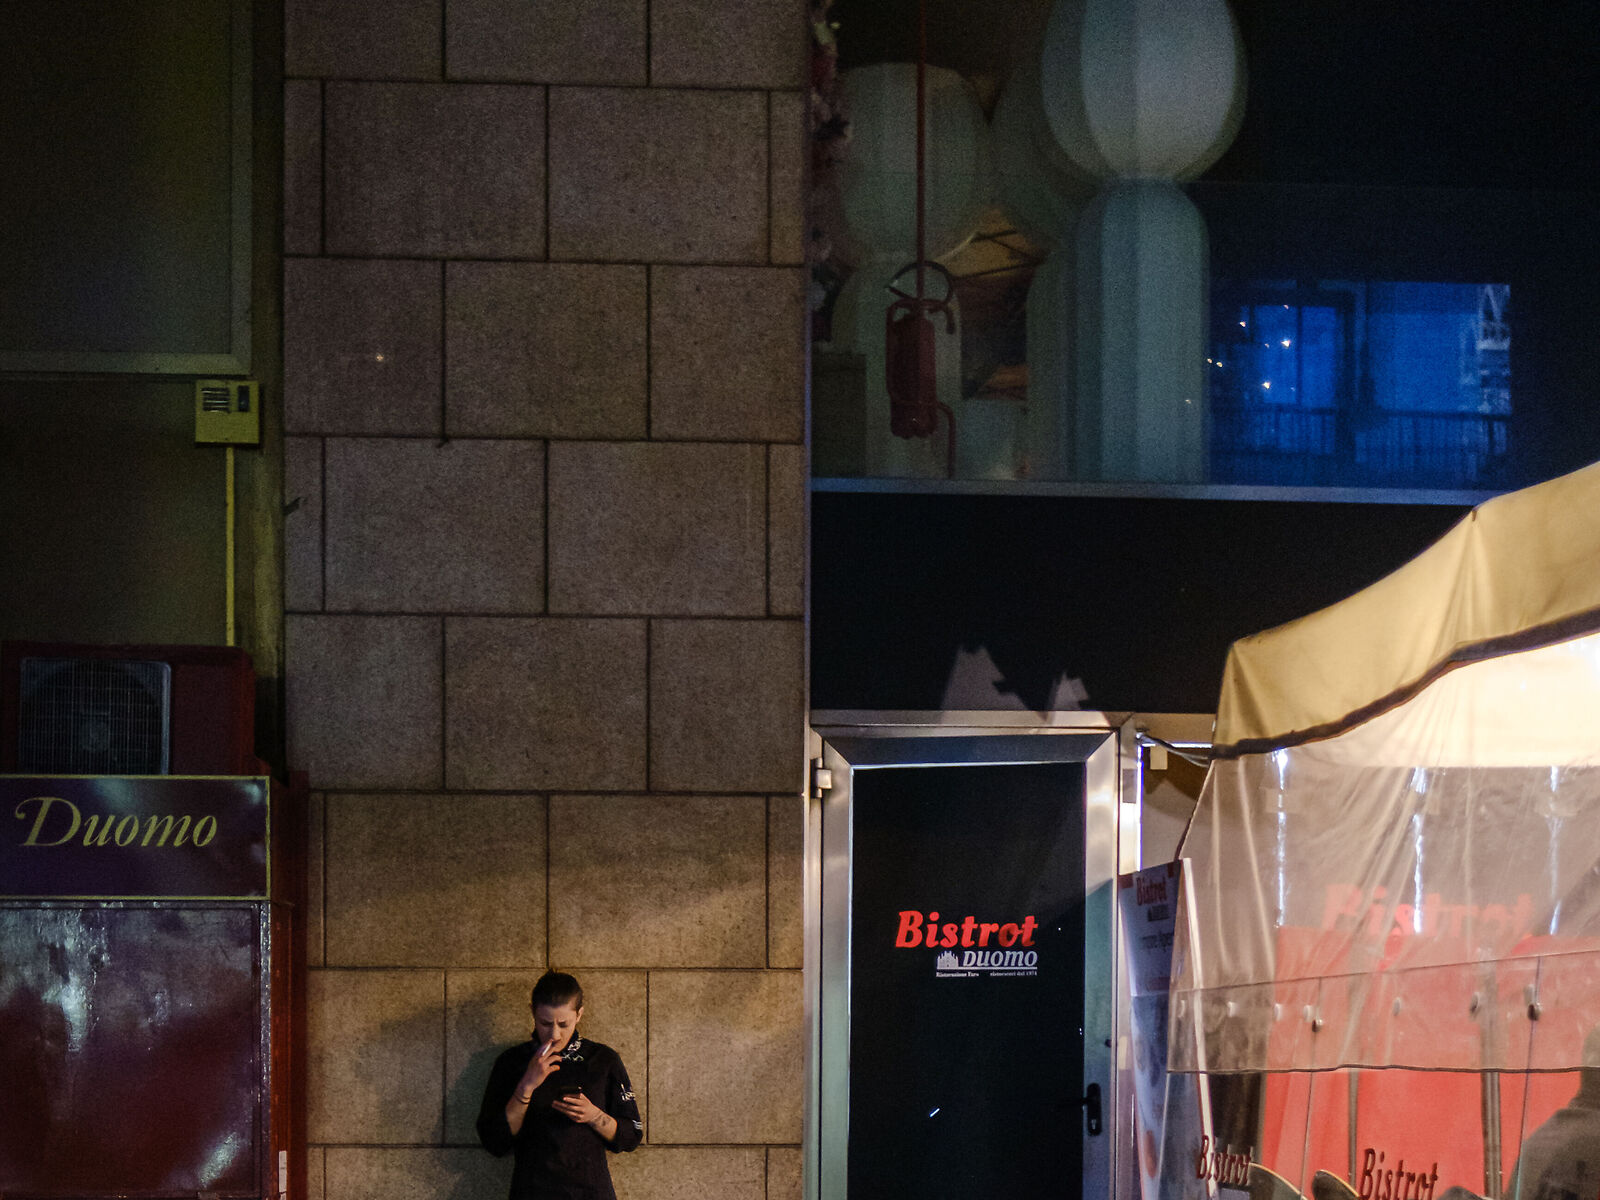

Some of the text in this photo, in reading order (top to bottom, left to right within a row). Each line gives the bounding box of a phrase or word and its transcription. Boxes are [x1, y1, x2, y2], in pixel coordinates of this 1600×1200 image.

[15, 796, 218, 847] Duomo
[895, 910, 1039, 948] Bistrot
[1196, 1135, 1252, 1186] Bistrot
